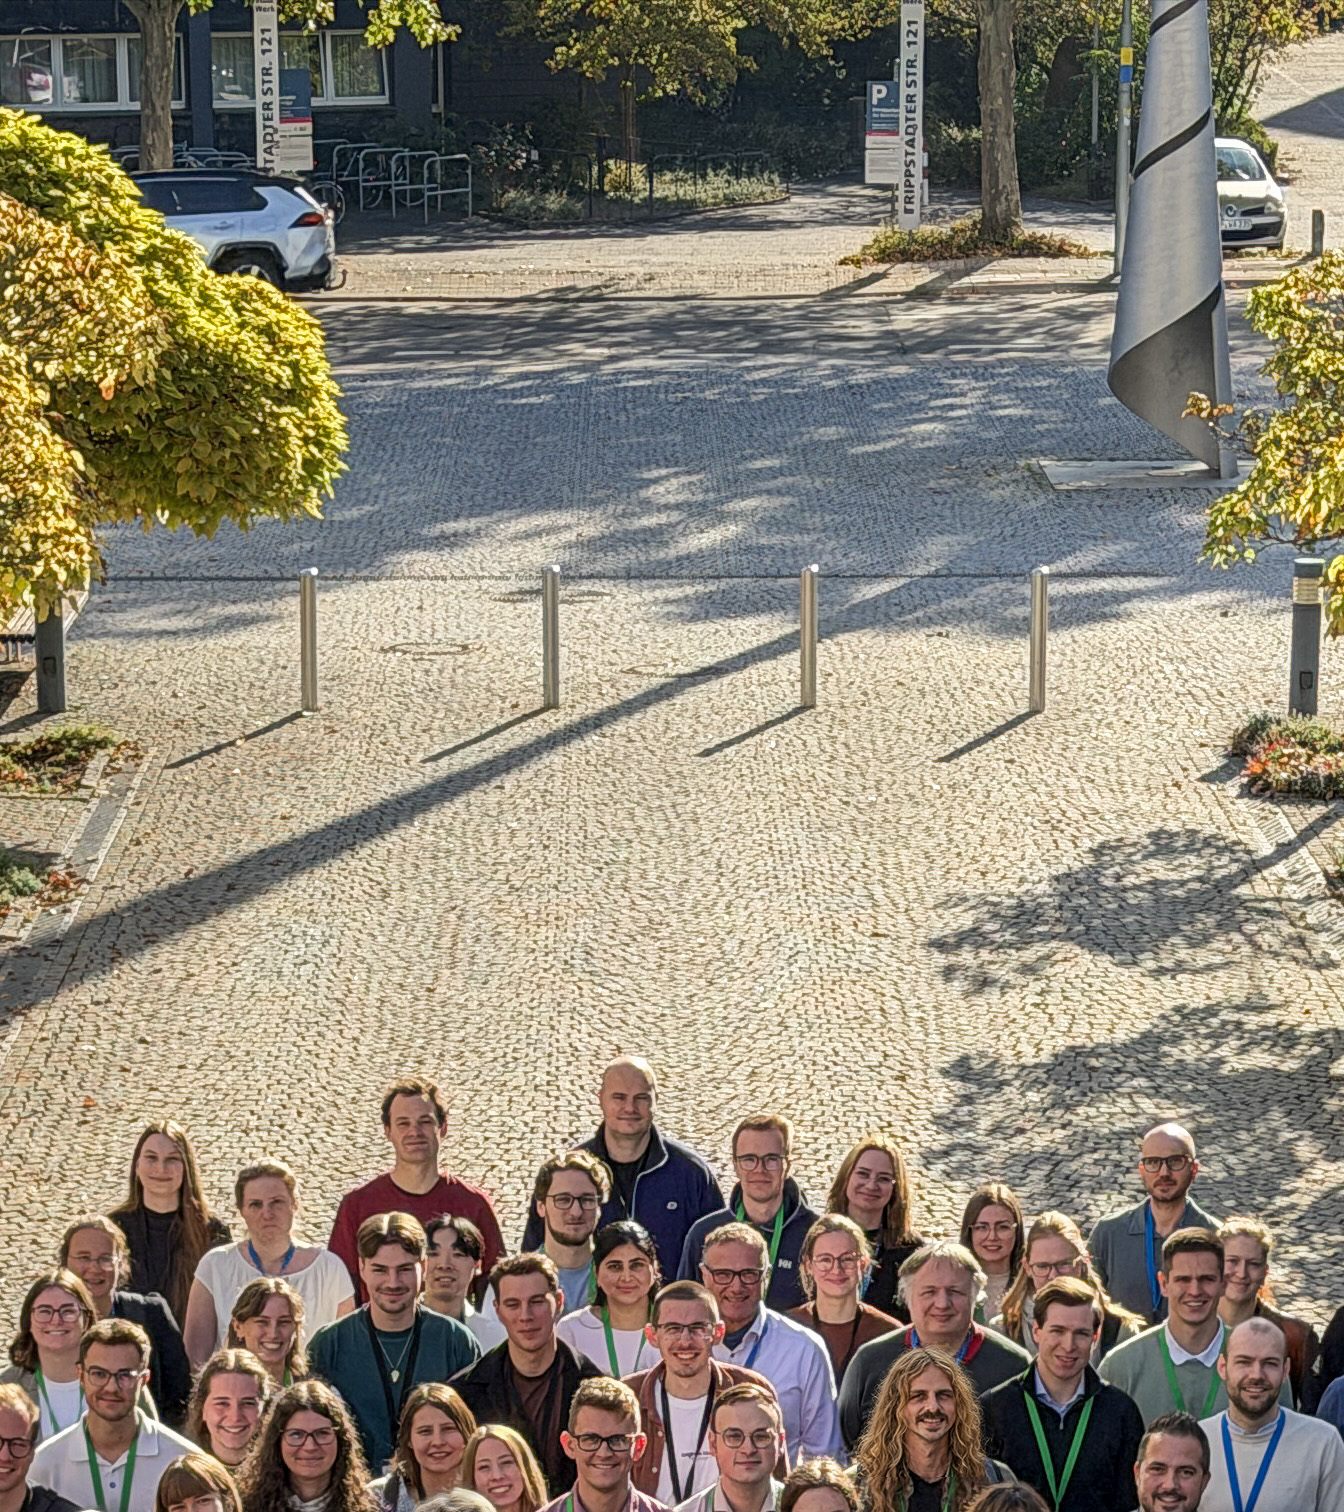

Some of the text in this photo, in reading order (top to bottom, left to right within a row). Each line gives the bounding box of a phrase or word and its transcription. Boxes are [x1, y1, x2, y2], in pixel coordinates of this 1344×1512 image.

[260, 28, 273, 56] 121
[907, 20, 919, 48] 121
[261, 61, 274, 96] STR.
[906, 54, 918, 89] STR.
[871, 84, 888, 105] P
